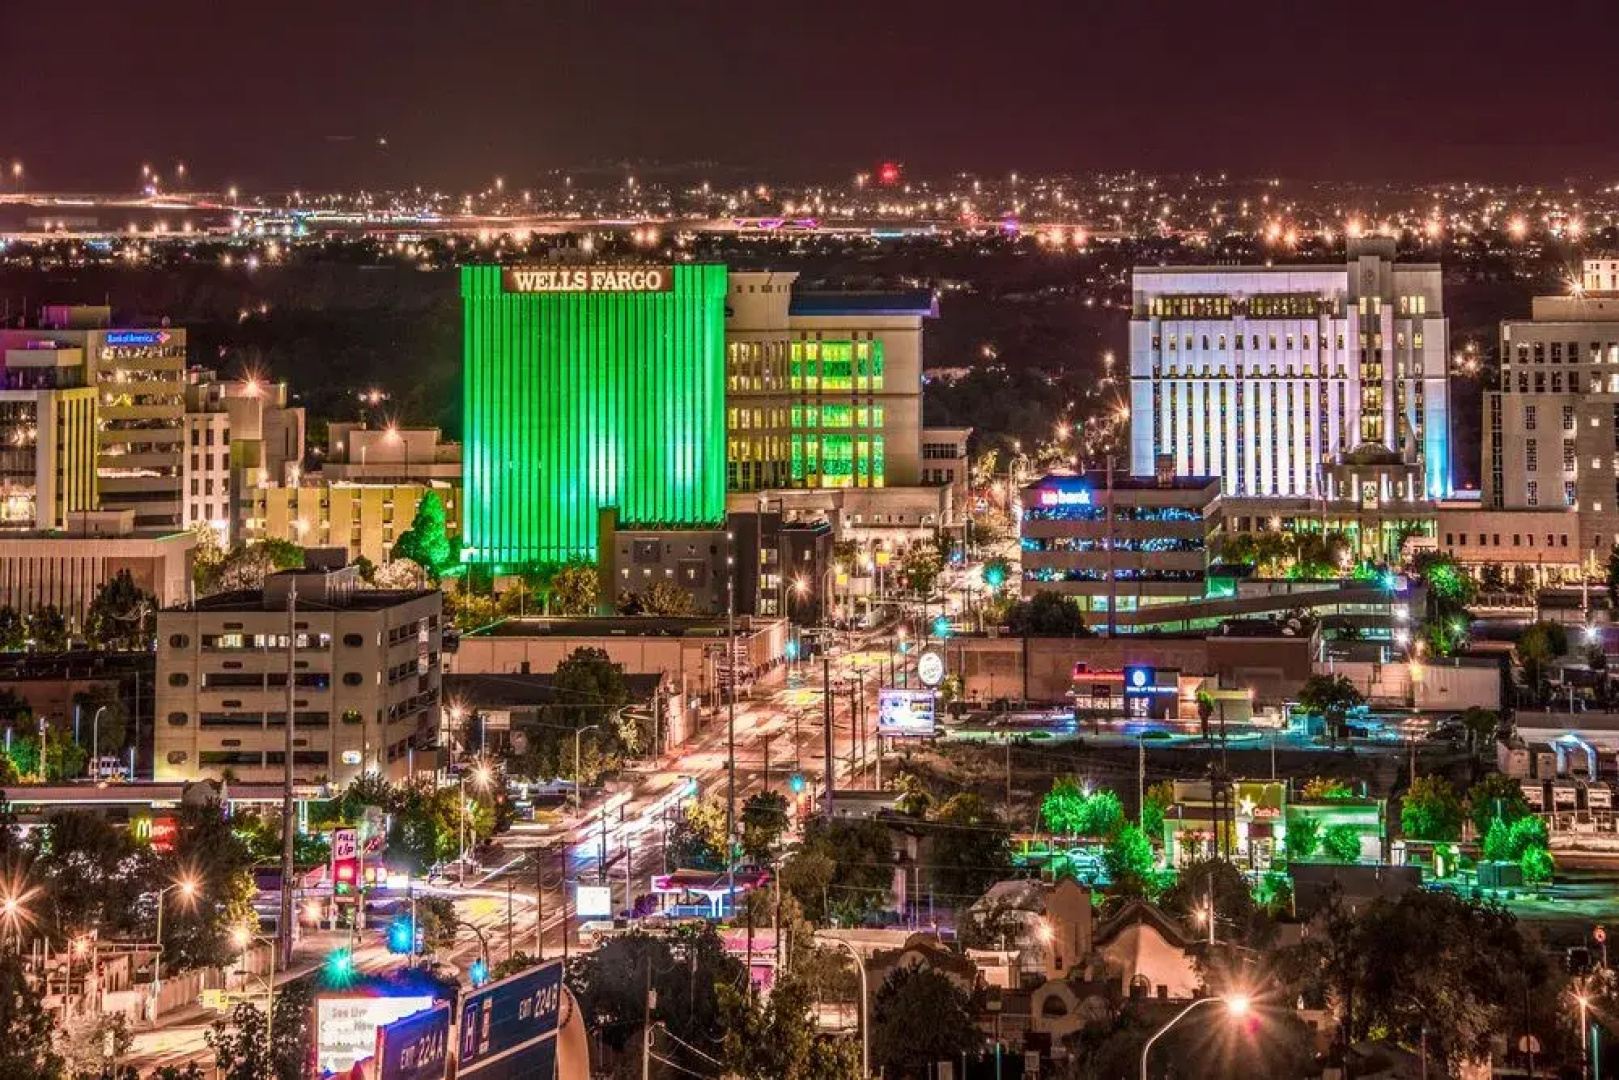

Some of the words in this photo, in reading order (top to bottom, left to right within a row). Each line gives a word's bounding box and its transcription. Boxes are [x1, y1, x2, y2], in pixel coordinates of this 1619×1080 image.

[513, 271, 587, 291] WELLS
[591, 271, 662, 291] FARGO
[338, 833, 354, 841] FILL
[338, 843, 354, 855] UP
